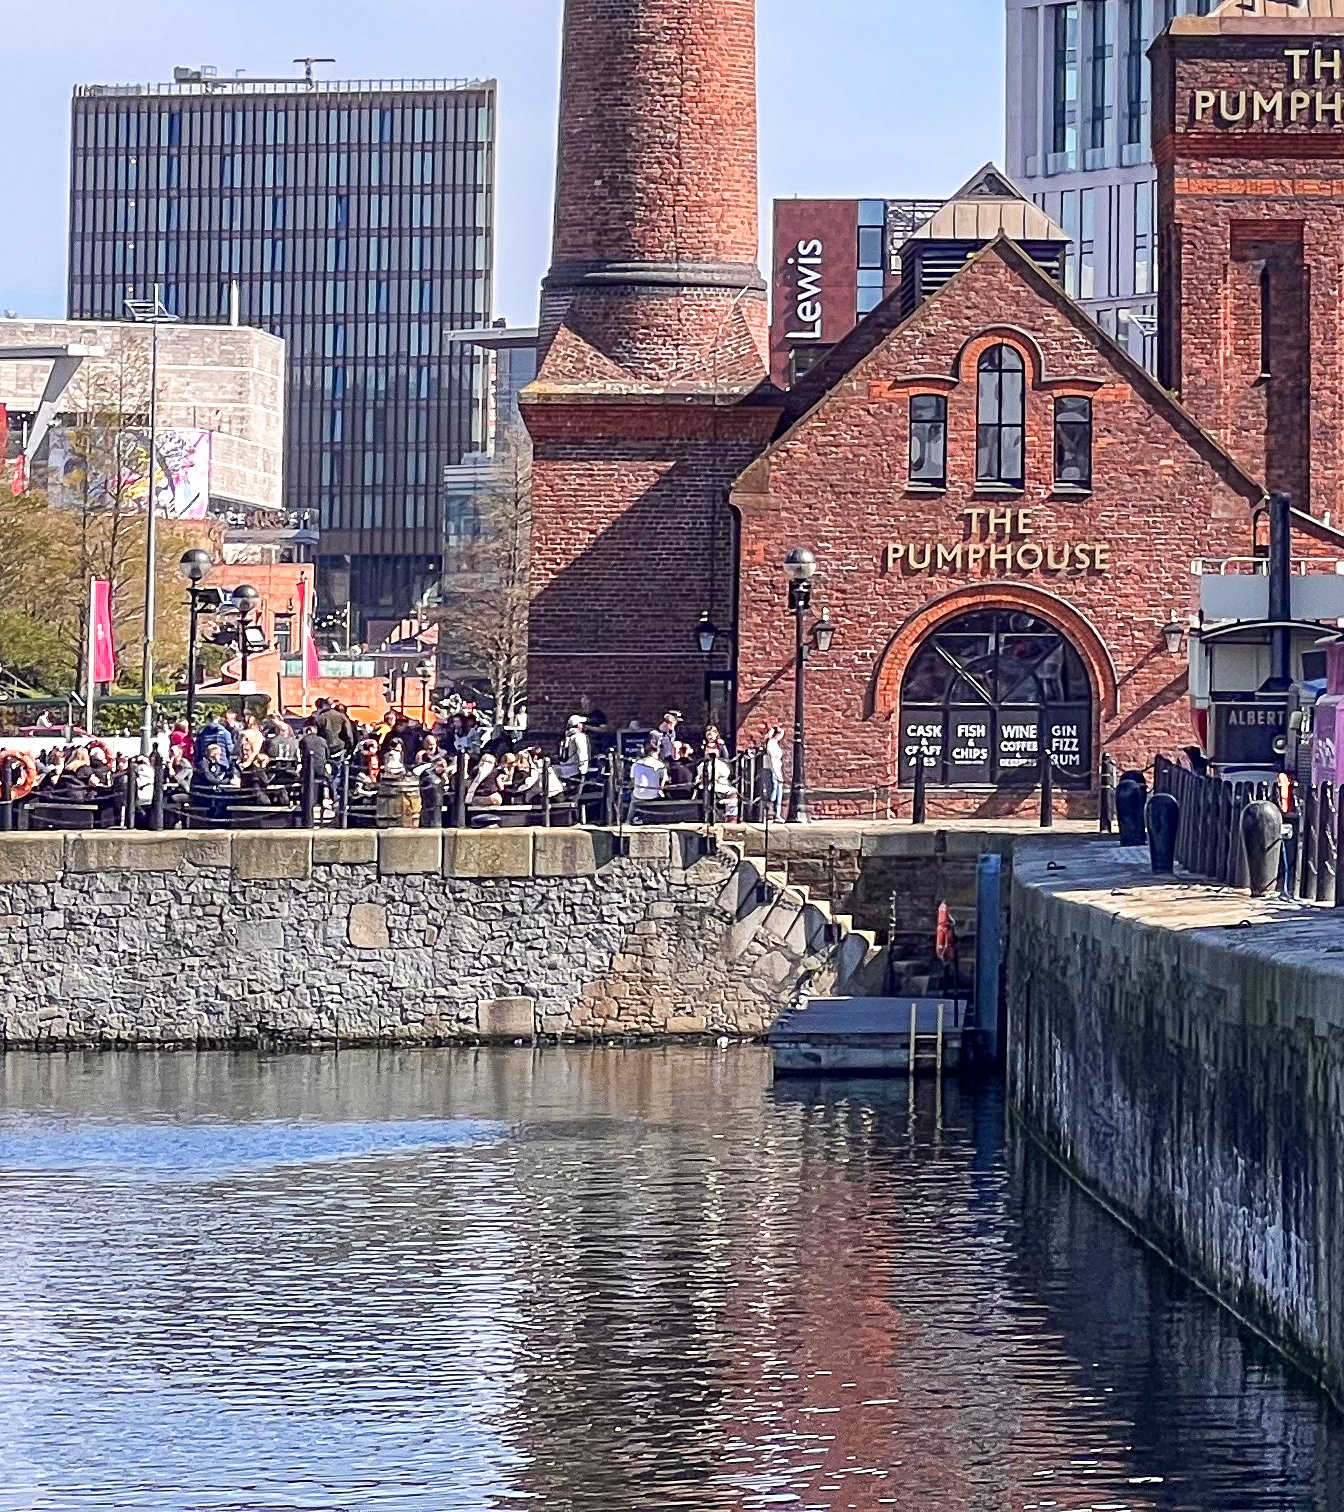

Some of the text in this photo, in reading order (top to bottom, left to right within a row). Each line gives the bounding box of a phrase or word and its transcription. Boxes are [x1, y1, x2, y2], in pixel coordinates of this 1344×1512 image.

[785, 239, 823, 338] Lewis
[964, 508, 1034, 534] THE
[886, 543, 1111, 570] PUMPHOUSE
[1228, 710, 1286, 726] ALBERT
[906, 724, 943, 738] CASK
[957, 724, 986, 738] FISH
[1001, 724, 1038, 739] WINE
[1051, 725, 1077, 737] GIN
[1052, 739, 1079, 752] FIZZ
[951, 748, 988, 760] CHIPS
[908, 756, 937, 767] AES
